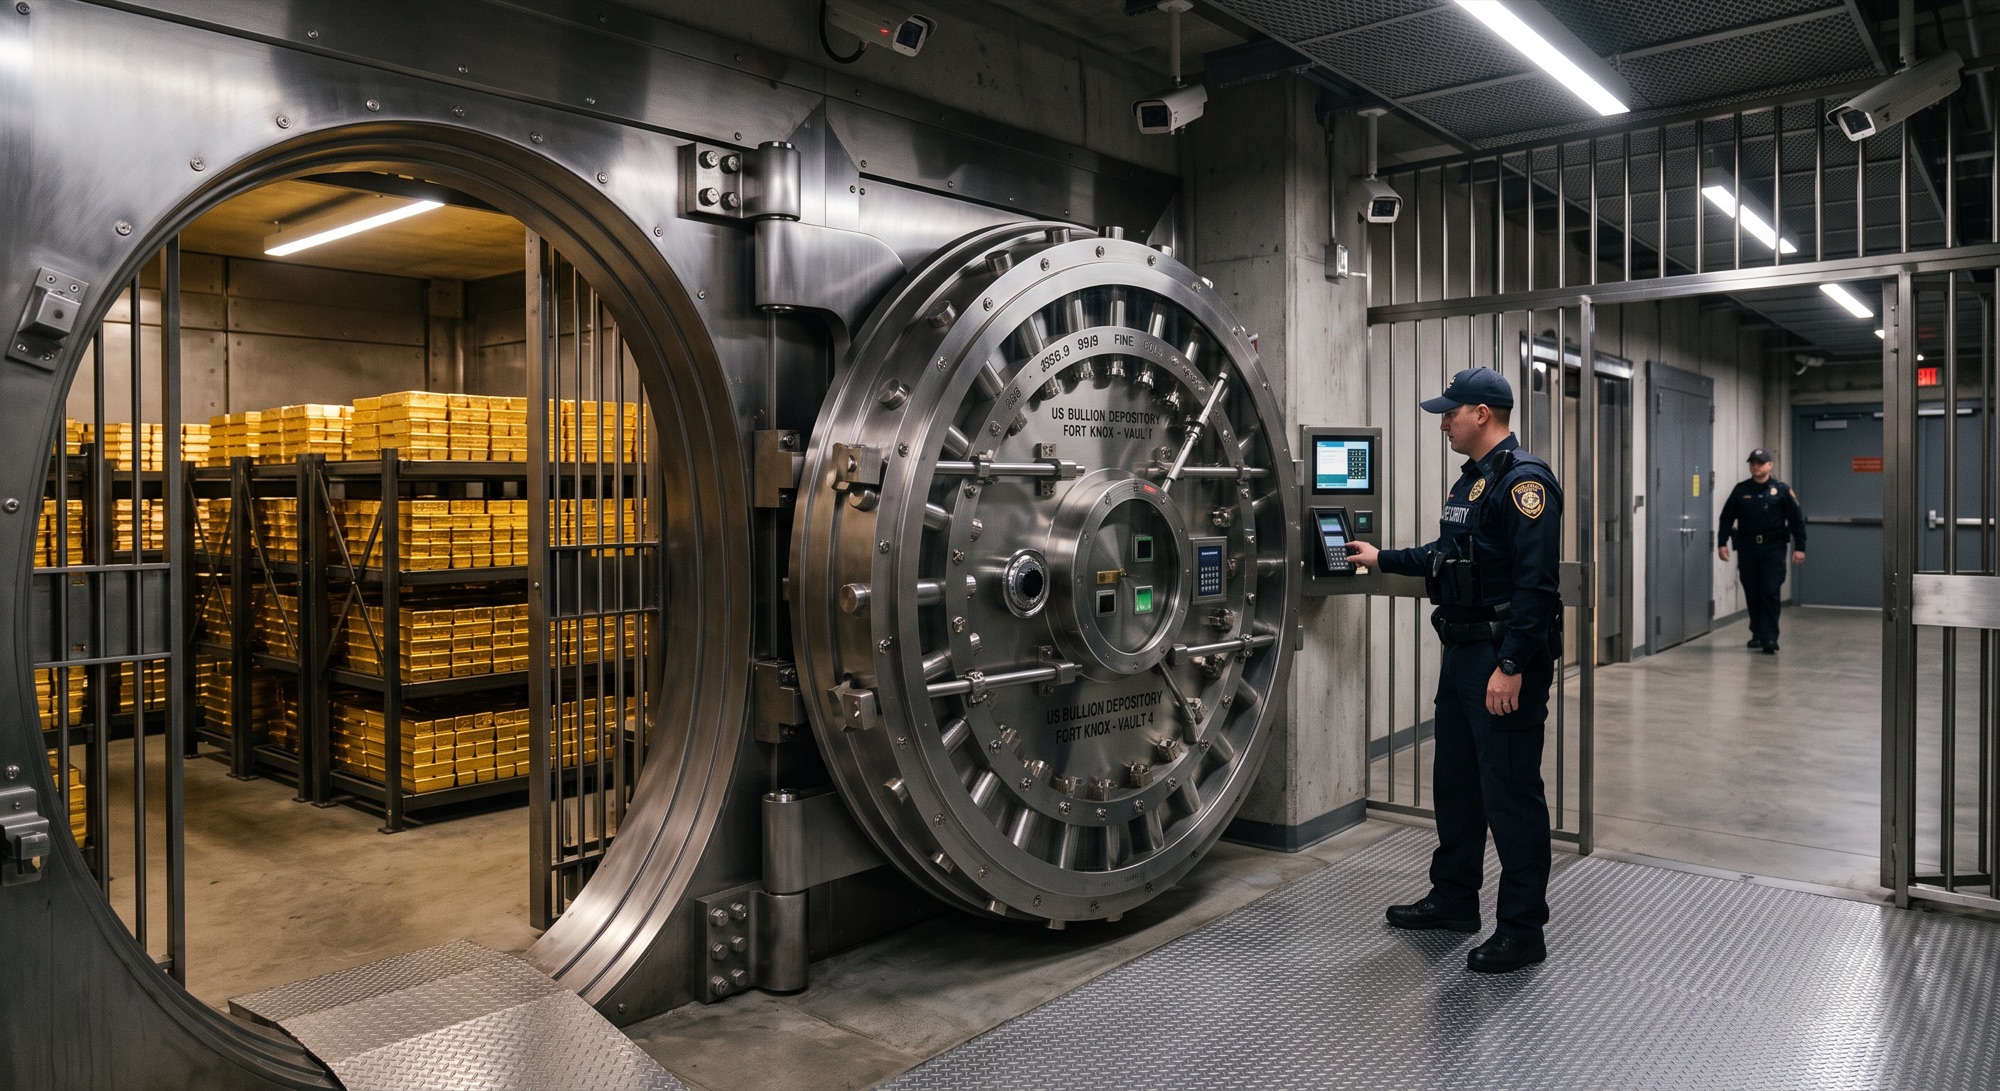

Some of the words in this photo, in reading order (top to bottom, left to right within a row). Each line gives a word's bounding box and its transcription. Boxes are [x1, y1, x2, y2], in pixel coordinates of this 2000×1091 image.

[1114, 334, 1134, 346] FINE
[1051, 407, 1064, 419] US
[1068, 408, 1105, 421] BULLION
[1109, 411, 1160, 424] DEPOSITORY
[1063, 425, 1086, 436] FORT
[1090, 426, 1114, 438] KNOX
[1047, 709, 1060, 725] US
[1062, 701, 1104, 722] BULLION
[1107, 690, 1163, 713] DEPOSITORY
[1056, 726, 1082, 744] FORT
[1084, 720, 1111, 738] KNOX
[1118, 713, 1146, 731] VAULT
[1148, 712, 1154, 724] 4
